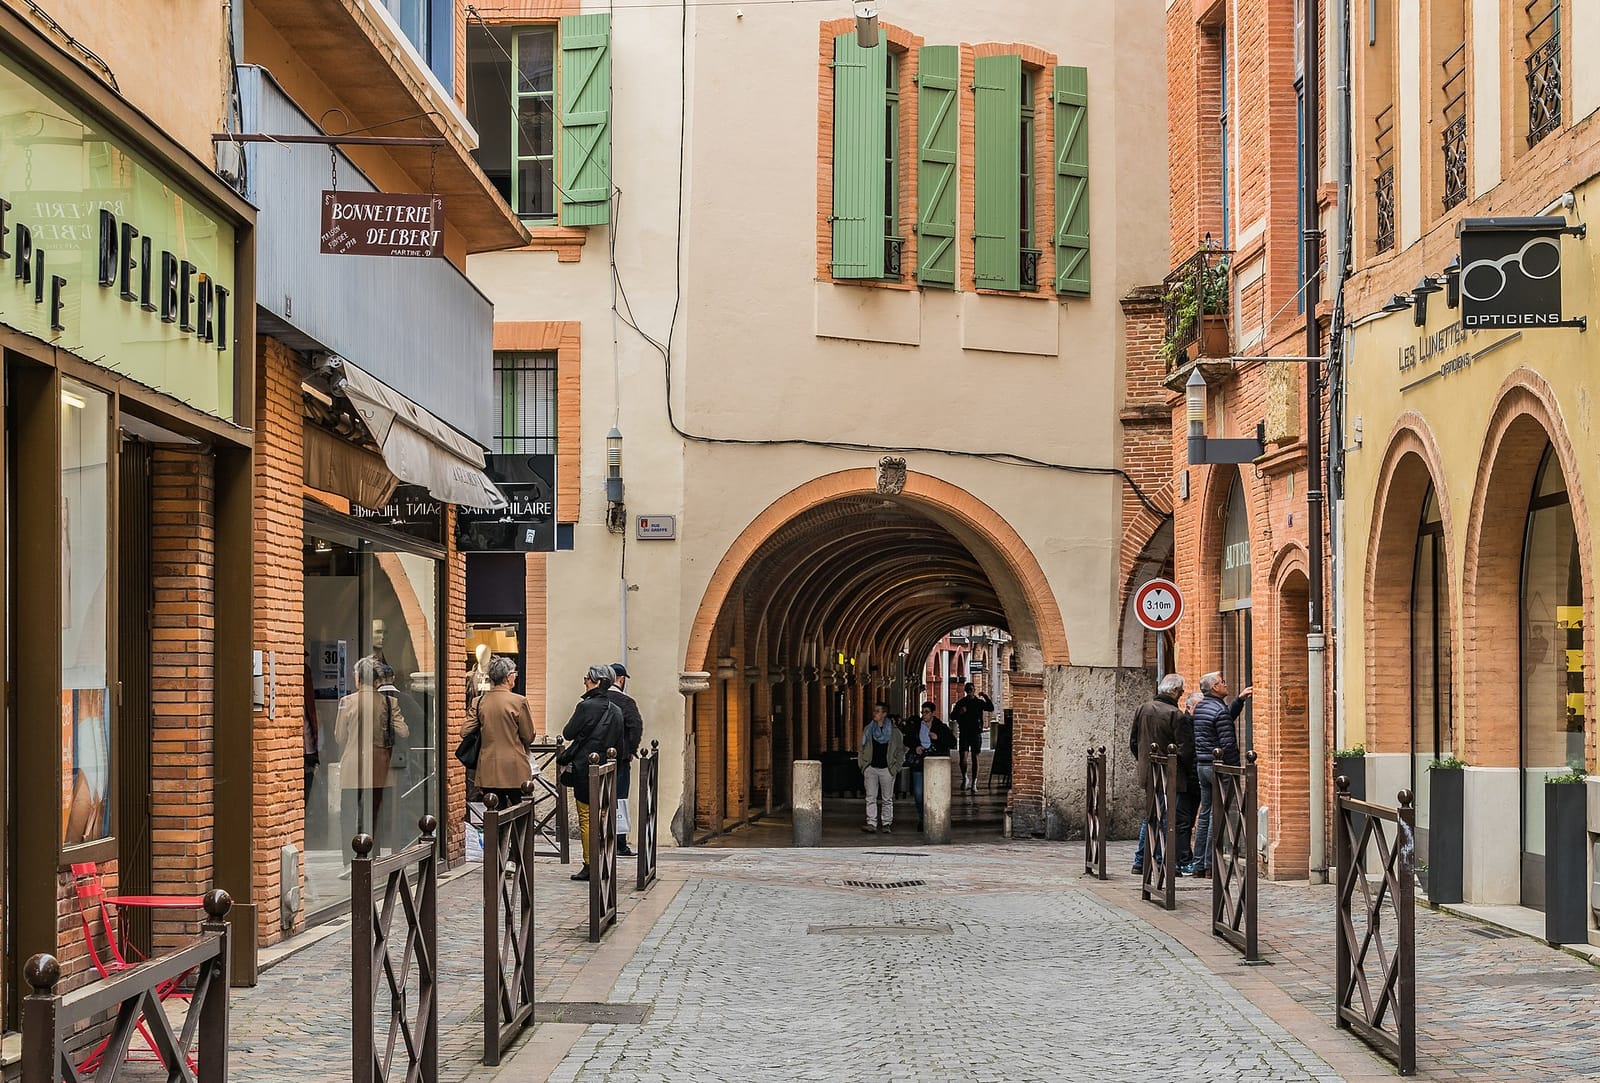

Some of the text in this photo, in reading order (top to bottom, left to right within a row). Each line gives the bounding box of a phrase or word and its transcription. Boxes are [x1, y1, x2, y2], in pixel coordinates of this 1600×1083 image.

[332, 203, 431, 224] BONNETERIE
[366, 228, 441, 247] DELBERT
[98, 208, 230, 351] DELBERT
[1466, 313, 1559, 325] OPTICIENS
[1398, 320, 1466, 371] LES LUNETTES
[1441, 352, 1470, 376] OPTICIENS
[503, 502, 552, 515] HILAIRE
[1146, 600, 1171, 610] 3.10m
